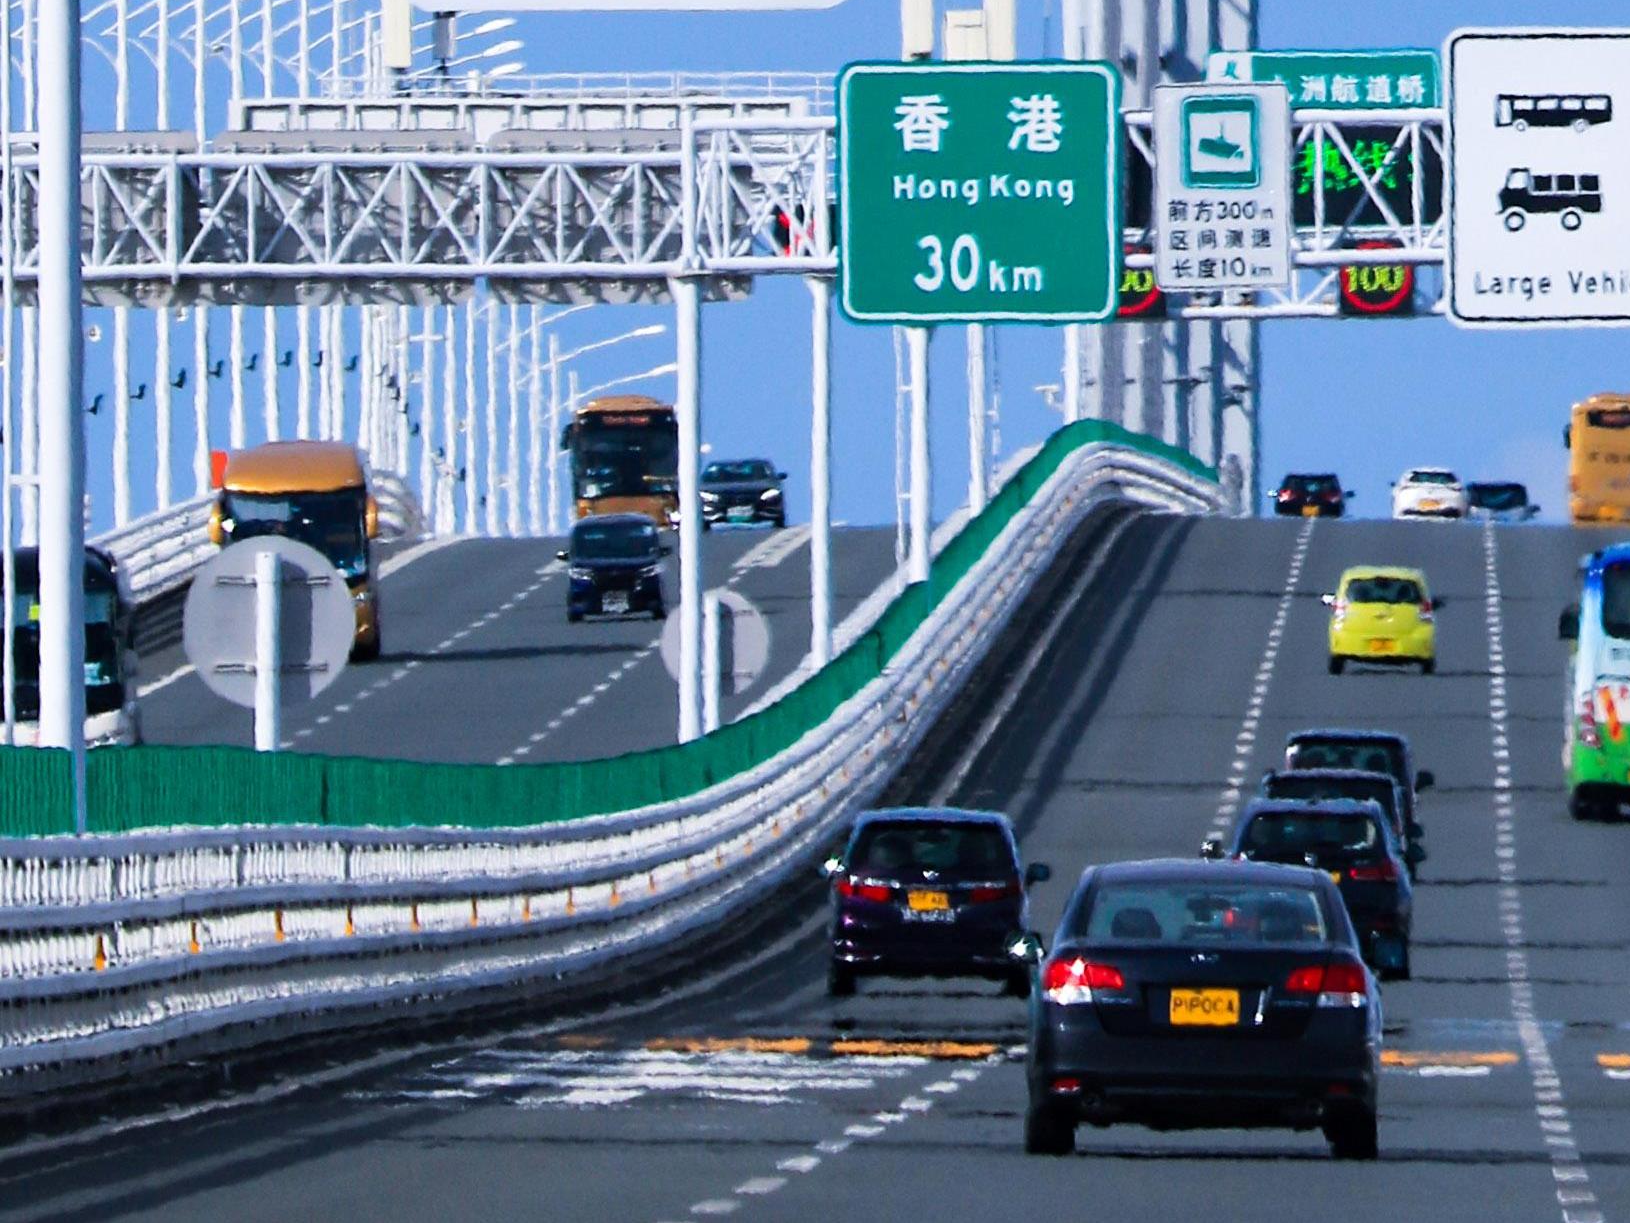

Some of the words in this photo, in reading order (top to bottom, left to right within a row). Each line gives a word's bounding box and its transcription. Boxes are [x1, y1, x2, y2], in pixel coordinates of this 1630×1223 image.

[1274, 74, 1427, 104] 洲航道桥
[893, 93, 1064, 153] 香港
[892, 174, 980, 206] Hong
[989, 173, 1075, 206] Kong
[1347, 265, 1405, 293] 100
[1473, 270, 1552, 301] Large
